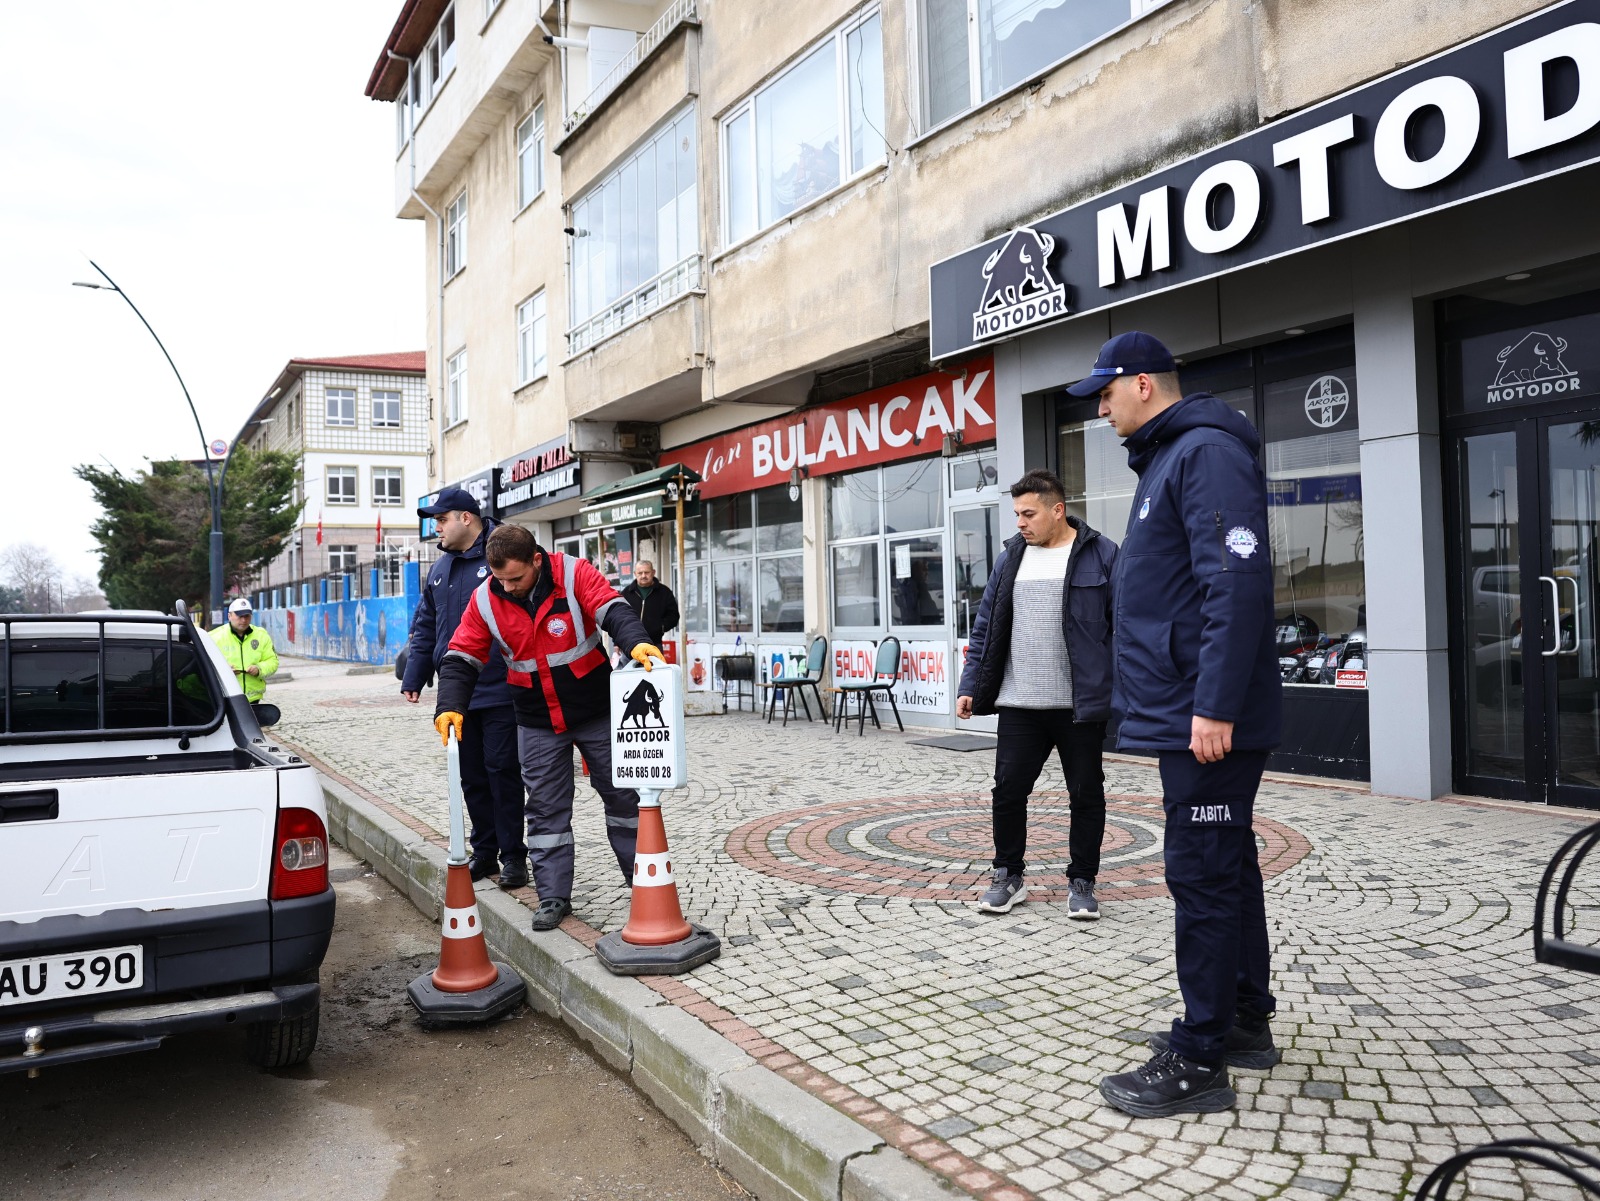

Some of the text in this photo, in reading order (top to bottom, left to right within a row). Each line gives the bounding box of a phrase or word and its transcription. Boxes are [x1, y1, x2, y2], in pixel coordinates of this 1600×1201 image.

[1097, 20, 1600, 289] MOTOD
[976, 295, 1062, 337] MOTODOR
[1308, 394, 1346, 408] ARORA
[1487, 377, 1580, 403] MOTODOR
[752, 370, 994, 478] BULANCAK
[836, 647, 873, 681] SALON
[617, 730, 670, 743] MOTODOR
[624, 748, 664, 759] ARDA ÖZGEN
[617, 766, 671, 779] 0546 685 00 28
[1190, 804, 1232, 822] ZABITA
[0, 952, 136, 999] AU 390
